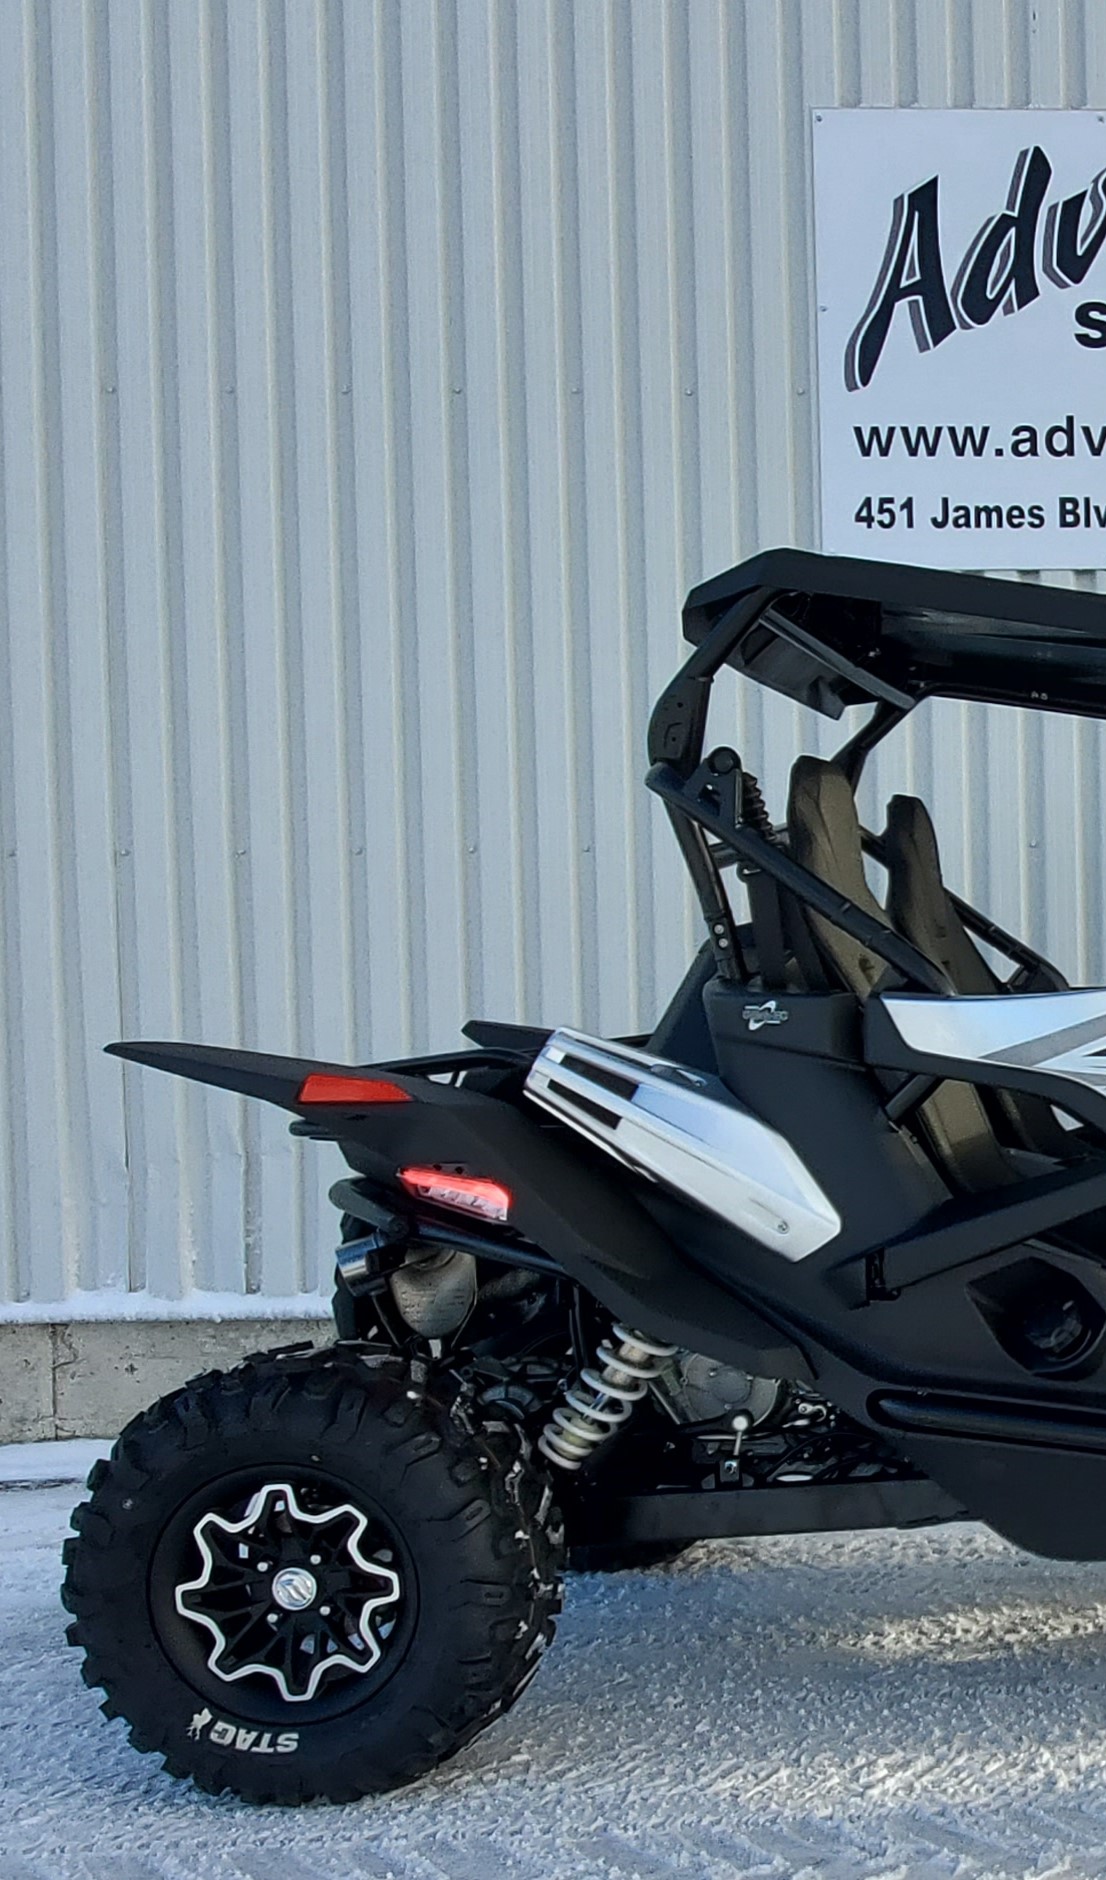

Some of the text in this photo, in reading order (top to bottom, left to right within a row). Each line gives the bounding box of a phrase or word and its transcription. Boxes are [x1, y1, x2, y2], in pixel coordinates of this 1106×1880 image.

[854, 496, 915, 529] 451
[930, 496, 1045, 530] James
[210, 1721, 300, 1753] STAG
